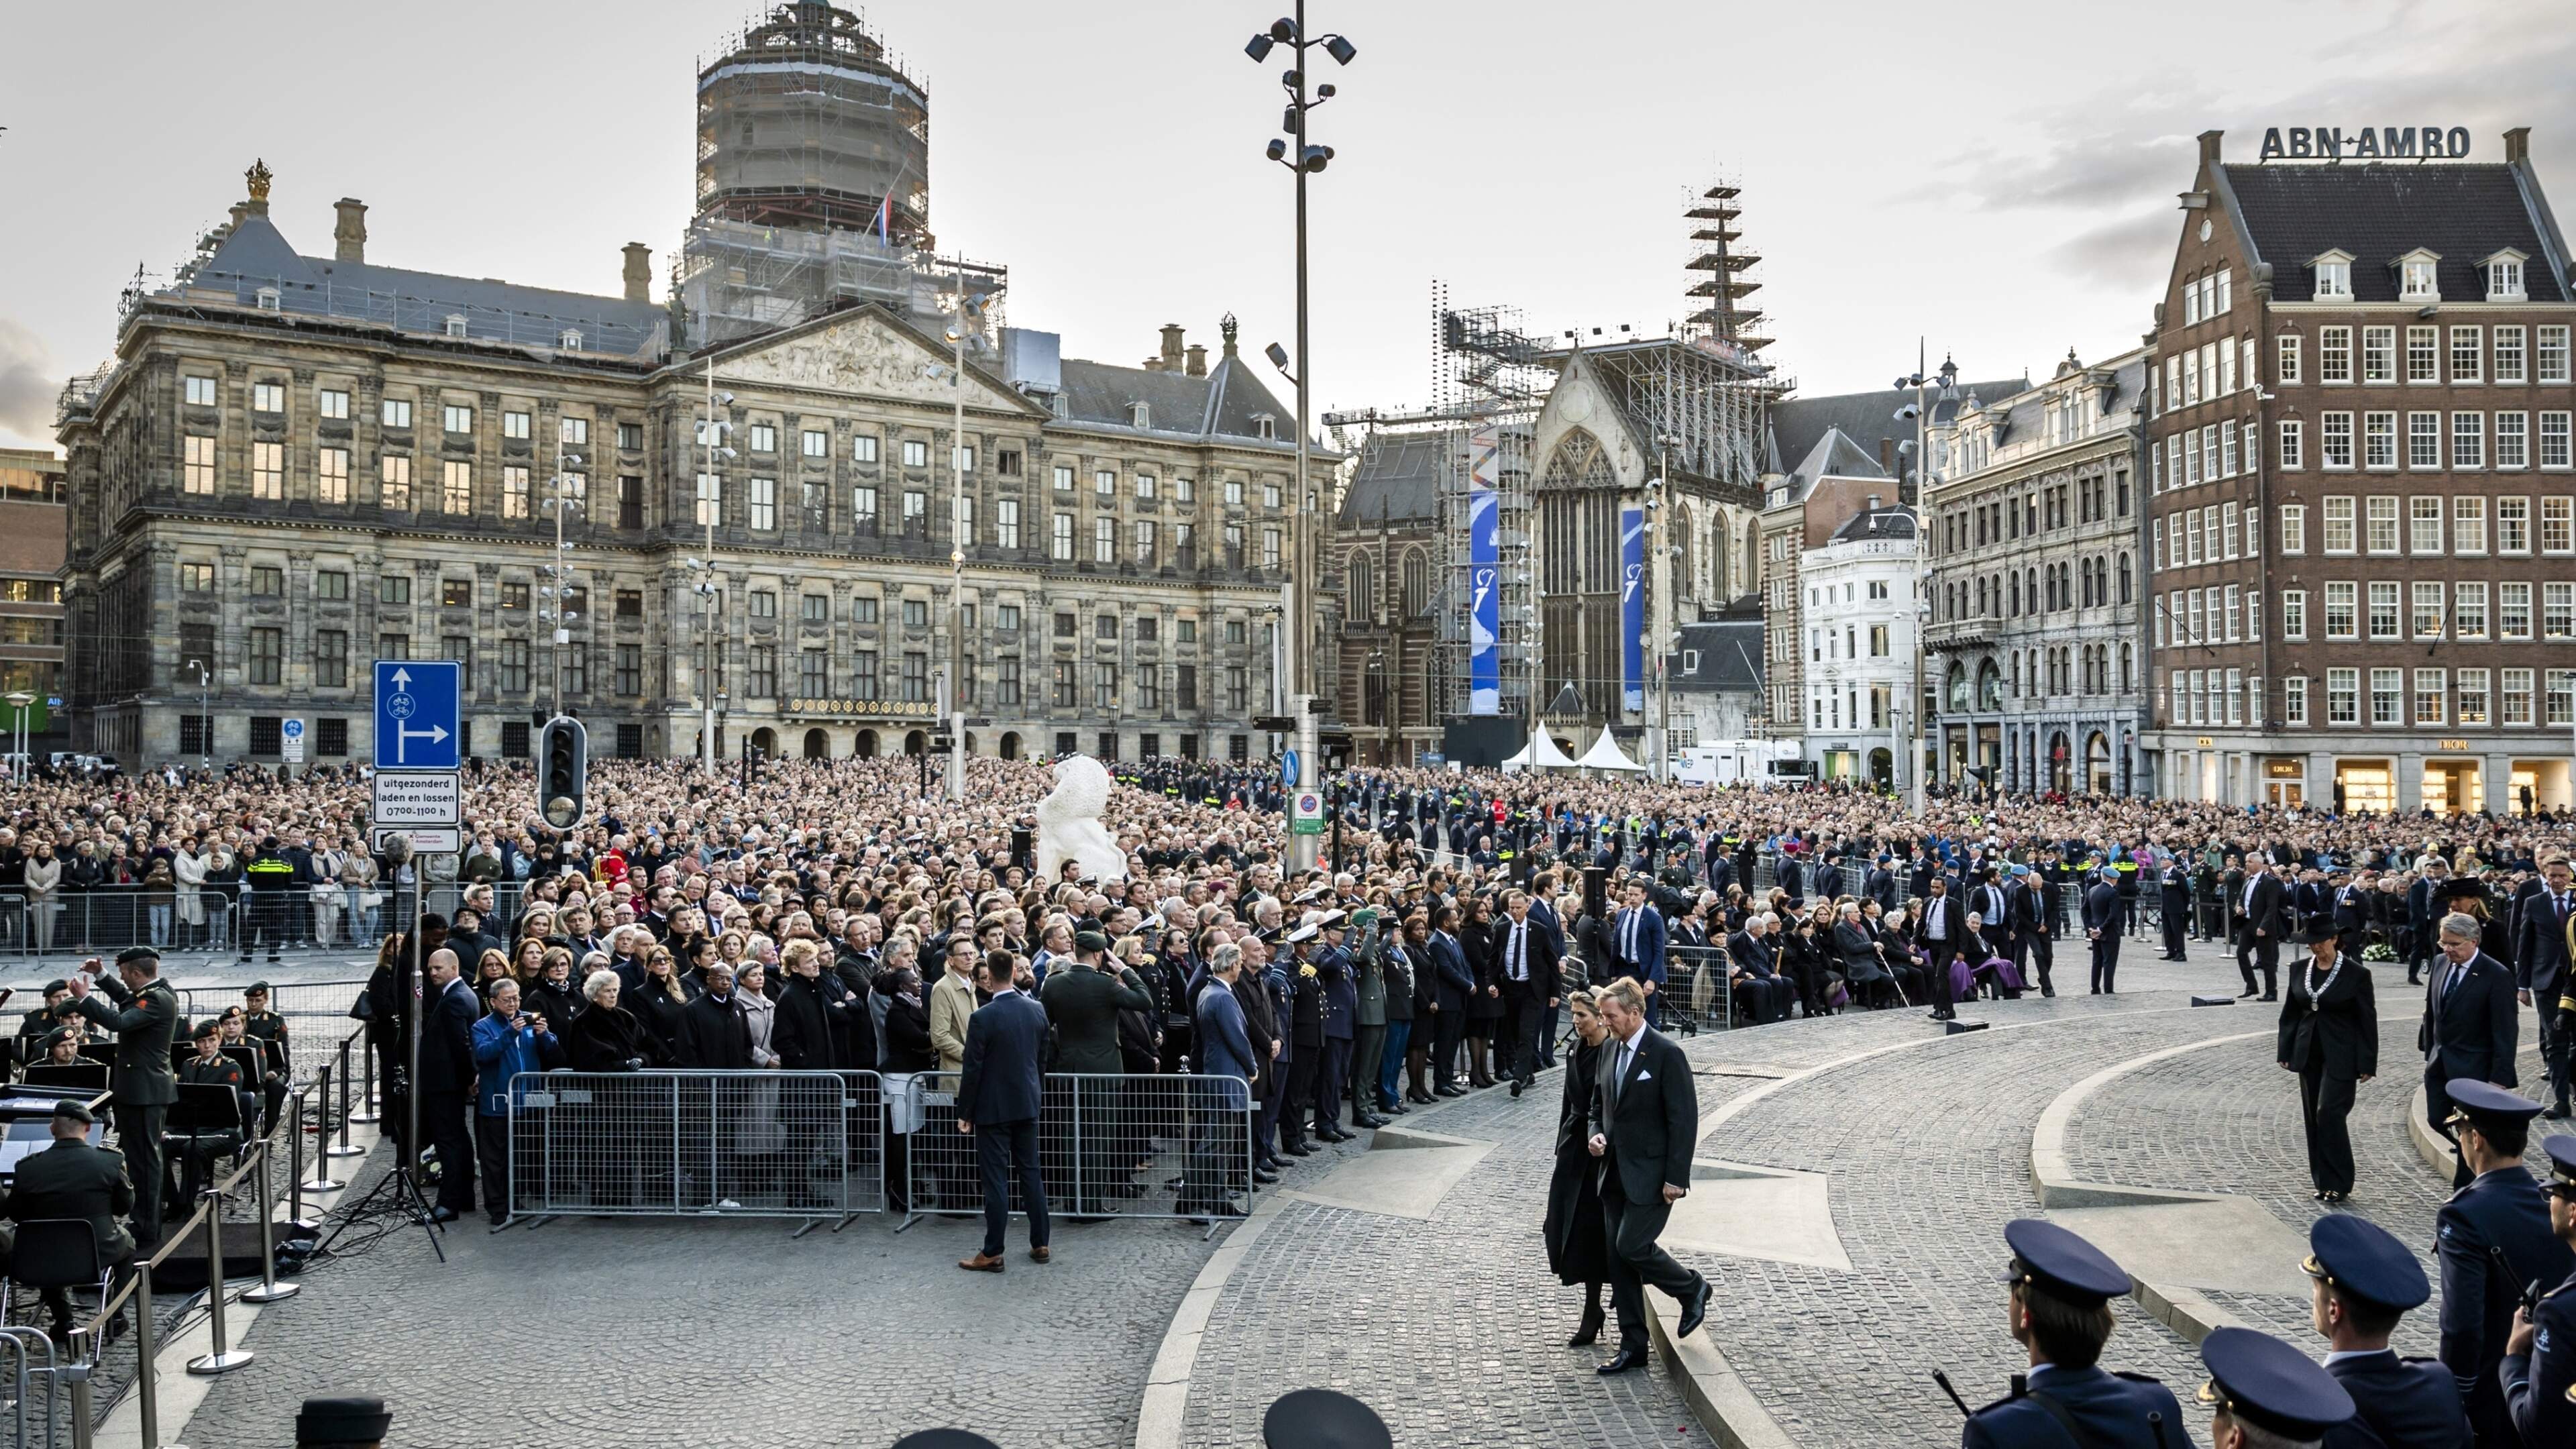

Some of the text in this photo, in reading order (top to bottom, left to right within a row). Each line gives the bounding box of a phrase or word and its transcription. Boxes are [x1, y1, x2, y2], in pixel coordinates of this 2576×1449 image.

[2260, 127, 2471, 158] ABN AMRO
[2439, 740, 2469, 750] DIOR
[384, 779, 449, 790] uitgezonderd
[378, 793, 405, 802] laden
[423, 794, 455, 802] lossen
[440, 808, 445, 816] h
